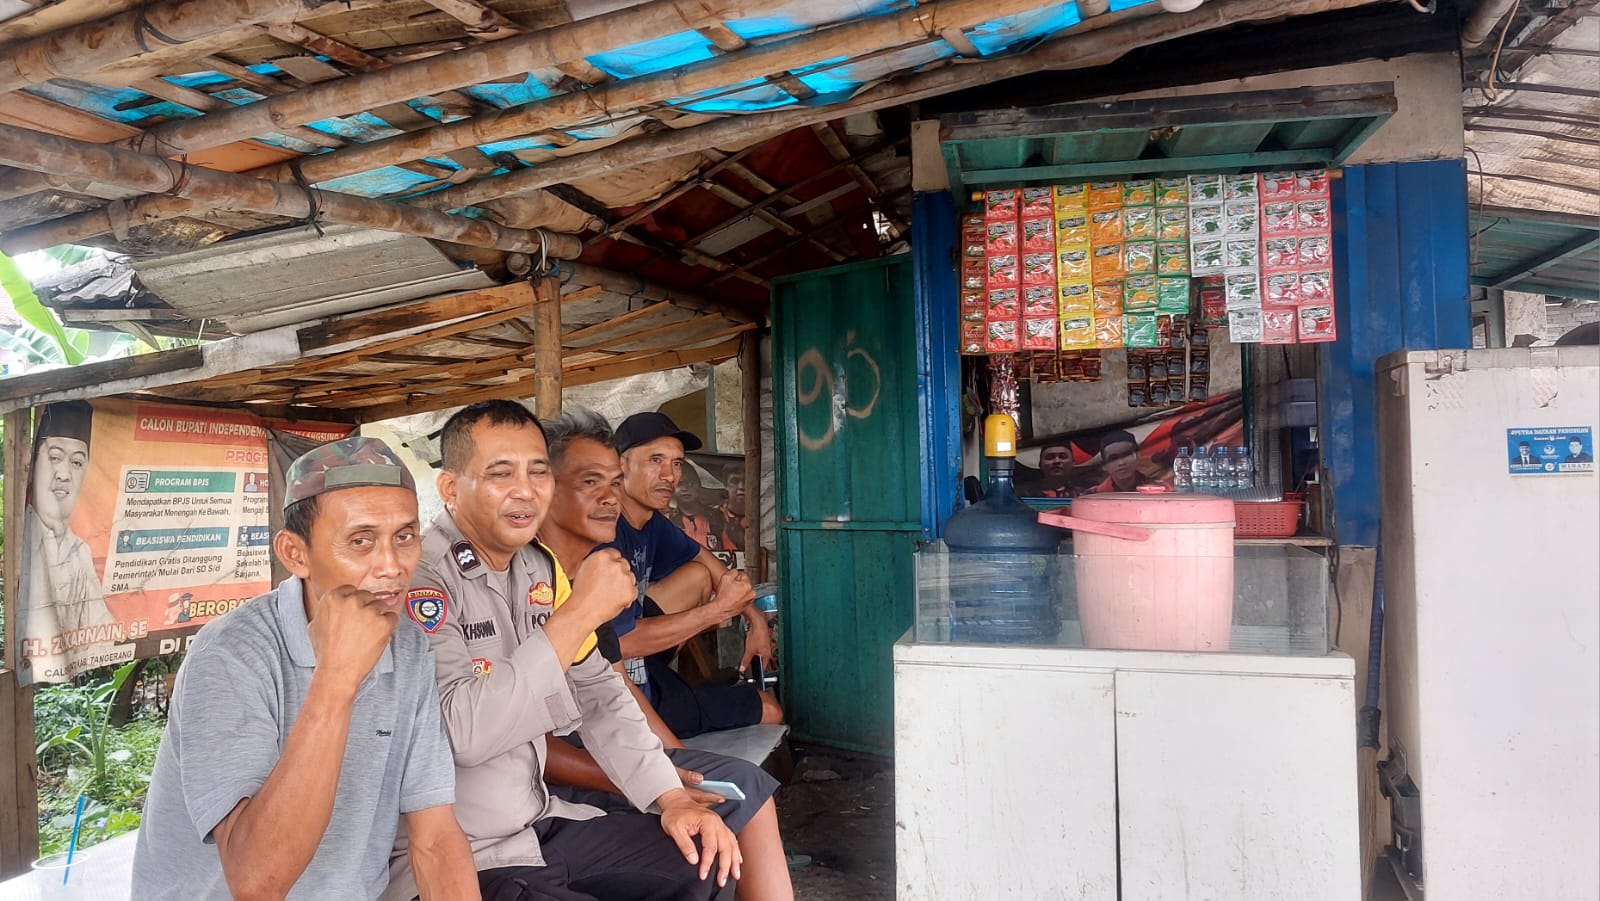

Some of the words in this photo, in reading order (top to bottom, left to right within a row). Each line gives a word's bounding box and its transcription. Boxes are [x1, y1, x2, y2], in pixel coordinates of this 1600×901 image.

[140, 418, 173, 432] CALON
[176, 420, 207, 434] BUPATI
[154, 477, 191, 487] PROGRAM
[192, 477, 210, 487] BPJS
[126, 497, 172, 507] Mendapatkan
[173, 497, 190, 505] BPJS
[210, 496, 232, 504] Semua
[125, 509, 163, 519] Masyarakat
[165, 509, 197, 517] Menengah
[135, 535, 175, 546] BEASISWA
[176, 533, 221, 544] PENDIDIKAN
[115, 558, 157, 569] Pendidikan
[159, 556, 181, 566] Gratis
[182, 554, 222, 564] Ditanggung
[158, 567, 179, 577] Mulai
[180, 566, 195, 575] Dari
[196, 565, 207, 573] SD
[111, 583, 129, 593] SMA
[22, 638, 47, 657] H.
[129, 619, 148, 640] SE
[160, 638, 181, 655] DI
[90, 650, 132, 665] TANGERANG
